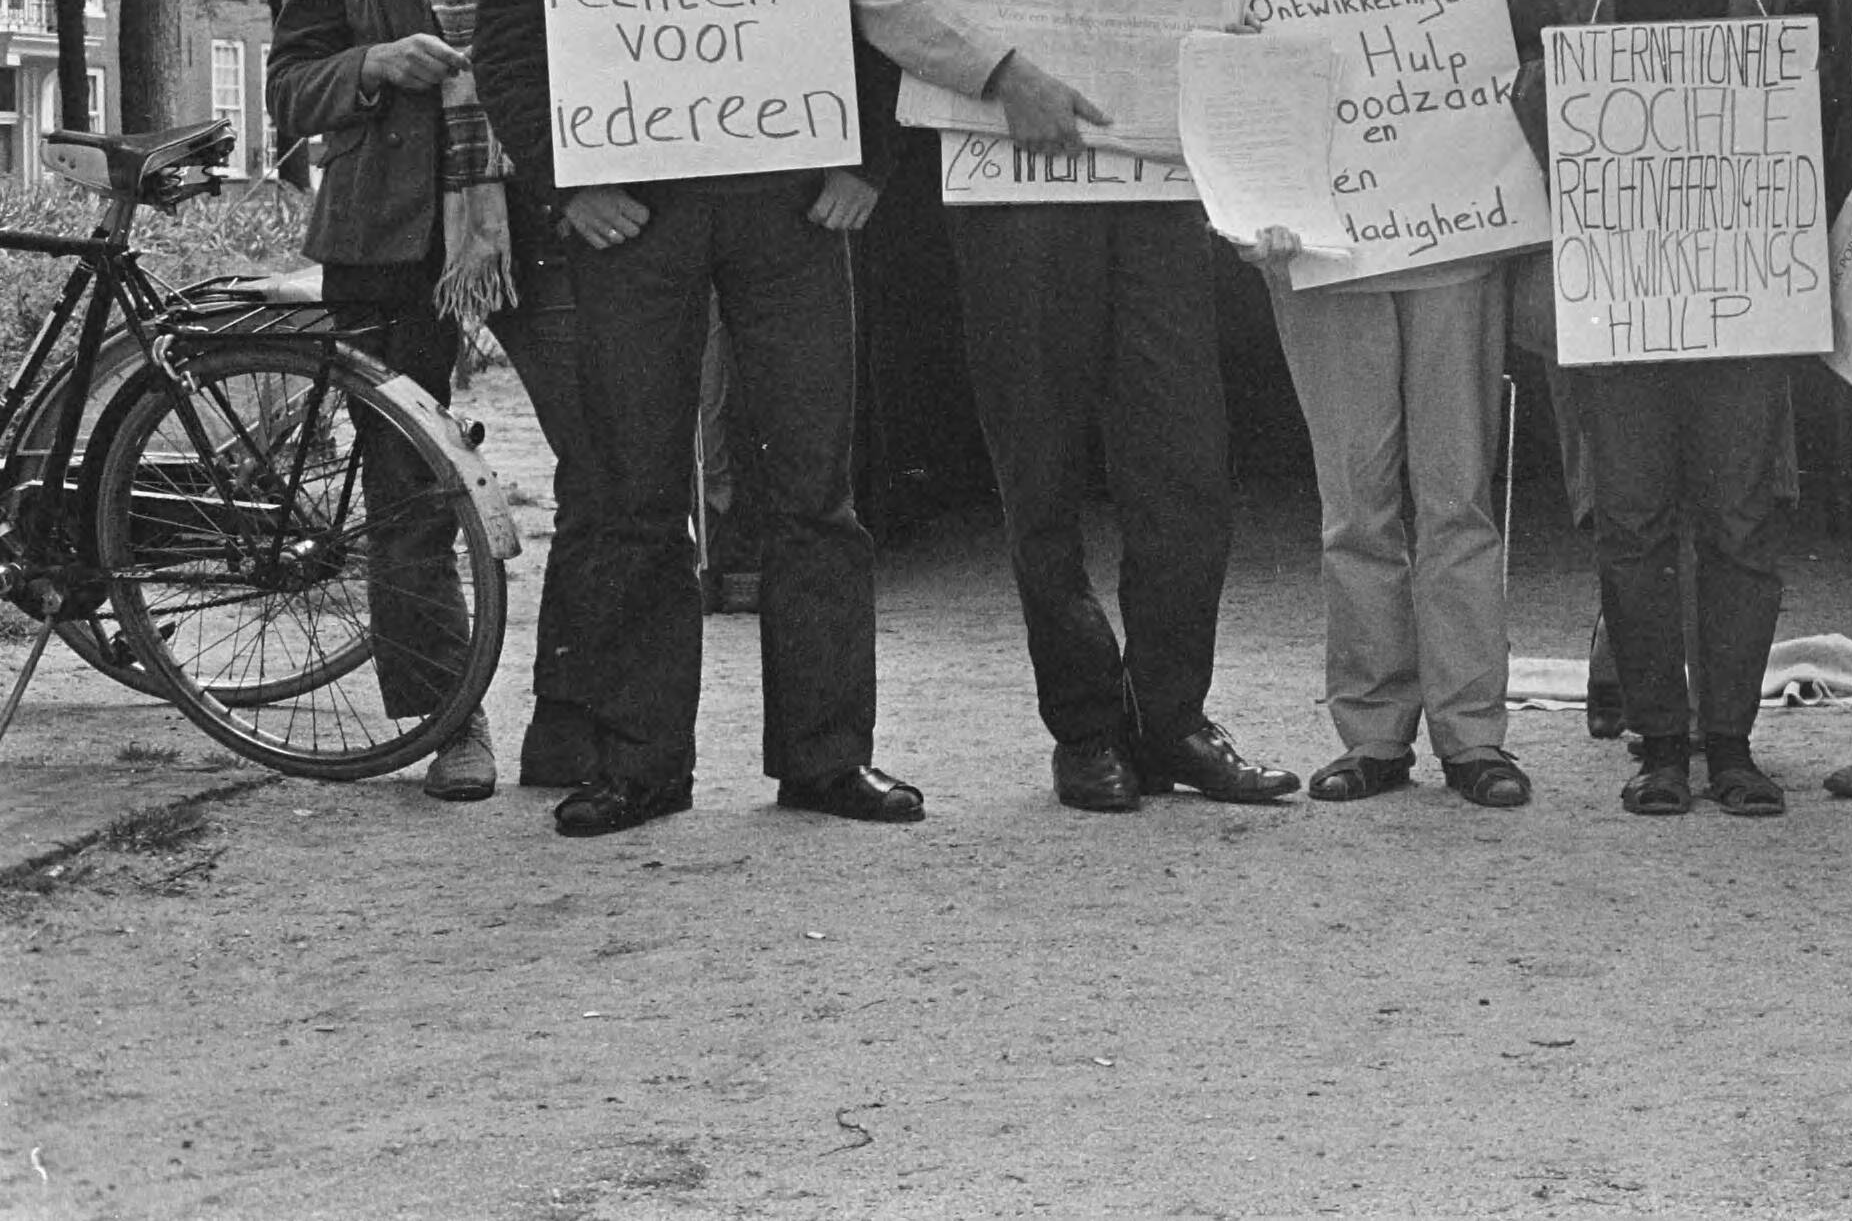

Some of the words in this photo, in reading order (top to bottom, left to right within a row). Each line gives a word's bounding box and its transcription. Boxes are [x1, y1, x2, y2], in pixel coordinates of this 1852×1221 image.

[616, 20, 759, 62] voor
[1359, 24, 1468, 83] Hulp
[1552, 21, 1809, 89] INTERNATIONALE
[556, 80, 848, 148] iedereen
[1363, 124, 1398, 143] en
[1558, 86, 1796, 157] SOCIALE
[1556, 154, 1819, 235] RECHTVAARDIGHEID
[1557, 227, 1819, 303] ONTWIKKELINGS
[1609, 294, 1753, 356] HULP
